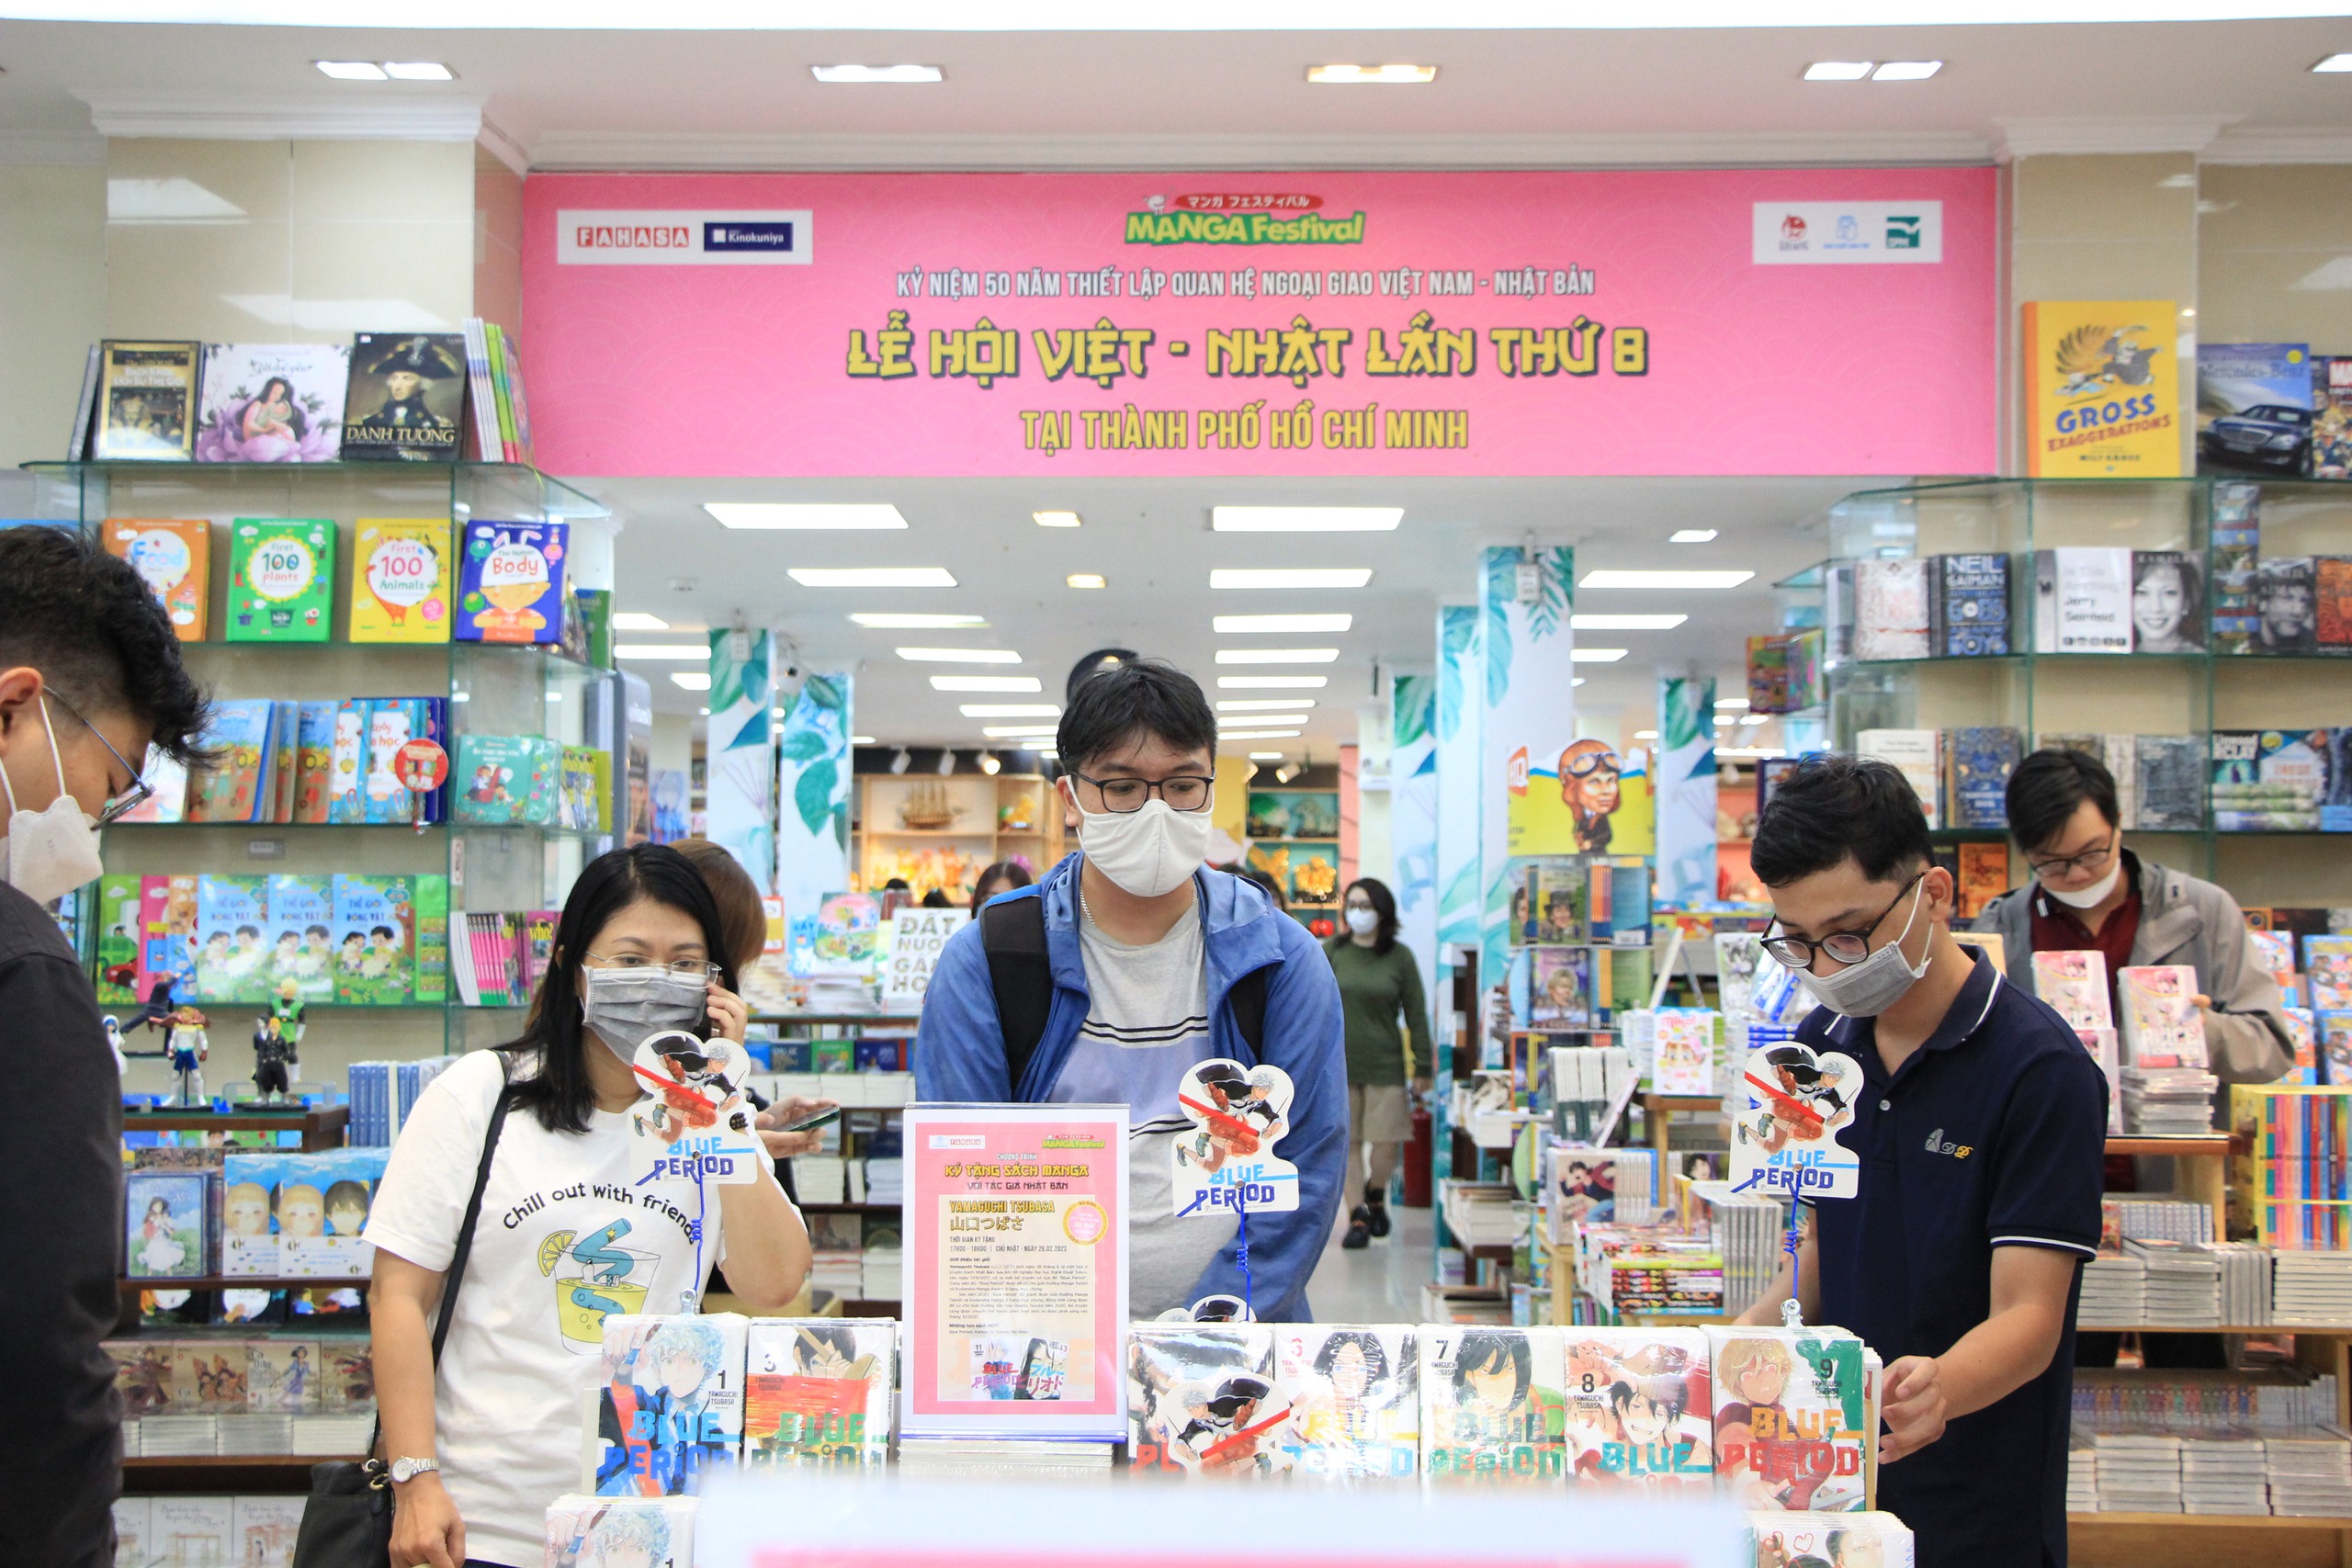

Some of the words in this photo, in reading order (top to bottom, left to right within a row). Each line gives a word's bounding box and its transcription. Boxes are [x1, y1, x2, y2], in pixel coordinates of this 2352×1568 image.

[578, 227, 689, 247] FAHASA
[1127, 212, 1249, 243] MANGA
[1251, 213, 1363, 242] Festival
[729, 231, 785, 246] Kinokuniya
[928, 267, 978, 299] NIỆM
[984, 272, 1010, 296] 50
[1015, 267, 1060, 297] NĂM
[1066, 265, 1123, 297] THIẾT
[1127, 267, 1166, 299] LẬP
[1170, 272, 1222, 298] QUAN
[1229, 267, 1256, 299] HỆ
[1261, 271, 1321, 299] NGOẠI
[1327, 272, 1375, 296] GIAO
[1380, 266, 1424, 299] VIỆT
[1429, 271, 1474, 296] NAM
[1495, 266, 1547, 299] NHẬT
[1552, 265, 1595, 297] BẢN
[847, 310, 917, 380] LỄ
[928, 316, 1020, 390] HỘI
[1032, 316, 1156, 390] VIỆT
[1206, 315, 1351, 389] NHẬT
[1489, 316, 1602, 378] THỨ
[1612, 326, 1650, 378] 8
[2057, 393, 2156, 434] GROSS
[346, 426, 394, 440] DANH
[1020, 410, 1072, 457] TẠI
[1080, 403, 1188, 451] THÀNH
[1198, 399, 1266, 451] PHỐ
[1271, 399, 1315, 450] HỒ
[1323, 402, 1379, 450] CHÍ
[1385, 410, 1469, 450] MINH
[263, 552, 300, 571] 100
[381, 556, 424, 577] 100
[492, 555, 539, 577] Body
[1947, 556, 2005, 573] NEIL
[379, 579, 425, 591] Animals
[666, 1136, 756, 1156] BLUE
[1043, 1140, 1074, 1148] MANGA
[944, 1162, 963, 1177] KÝ
[1003, 1161, 1039, 1177] SÁCH
[1042, 1165, 1090, 1177] MANGA
[1766, 1149, 1860, 1168] BLUE
[635, 1156, 734, 1186] PERIOD
[1207, 1164, 1298, 1186] BLUE
[1730, 1168, 1834, 1196] PERIOD
[503, 1191, 547, 1230] Chill
[552, 1182, 586, 1201] out
[593, 1182, 634, 1205] with
[949, 1200, 1008, 1213] YAMAGUCHI
[1010, 1200, 1056, 1213] TSUBASA
[1176, 1183, 1275, 1218] PERIOD
[949, 1215, 1025, 1232] 山口つばさ
[1435, 1339, 1449, 1360] 7
[763, 1353, 777, 1372] 3
[1430, 1361, 1459, 1370] AMAGUCHI
[1819, 1359, 1834, 1379] 9
[717, 1369, 727, 1390] 1
[1581, 1372, 1595, 1393] 8
[708, 1390, 739, 1398] YAMAGUCHI
[710, 1397, 735, 1405] TSUBASA
[1573, 1394, 1604, 1403] YAMAGUCHI
[1576, 1402, 1602, 1410] TSUBASA
[627, 1410, 741, 1445] BLUE
[775, 1412, 888, 1447] BLUE
[1747, 1406, 1864, 1441] BLUE
[1597, 1441, 1713, 1476] BLUE
[1715, 1442, 1860, 1479] PERIOD
